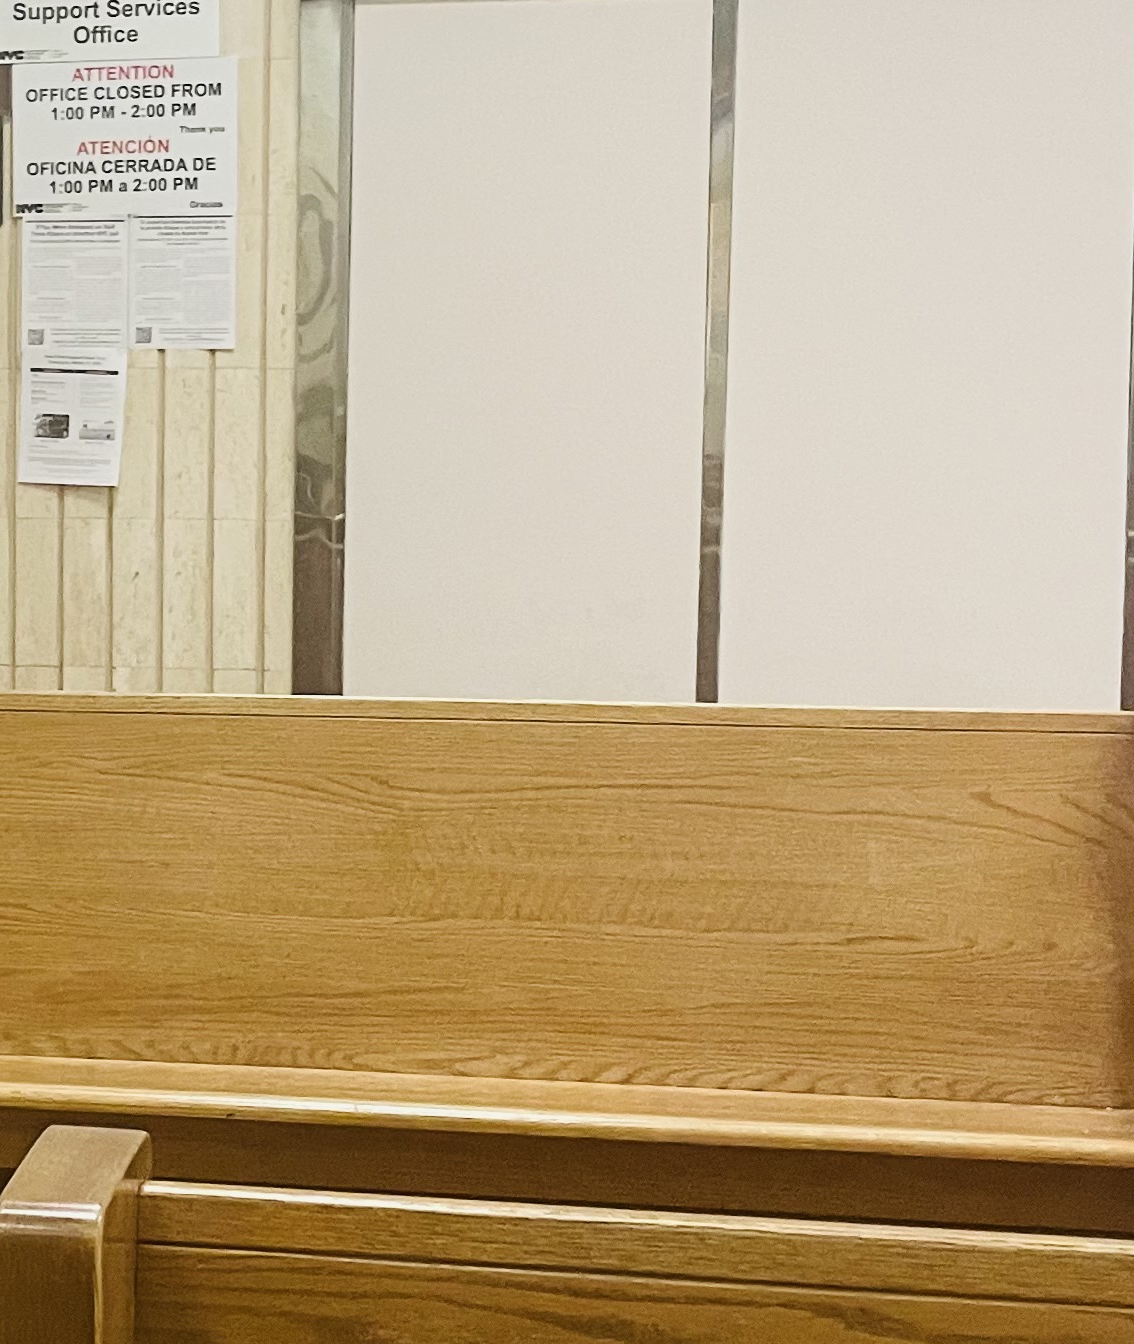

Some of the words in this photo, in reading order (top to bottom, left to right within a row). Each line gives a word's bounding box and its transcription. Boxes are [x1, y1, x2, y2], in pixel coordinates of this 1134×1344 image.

[13, 2, 100, 24] Support
[73, 25, 138, 44] Office
[72, 64, 175, 82] ATTENTION
[26, 87, 88, 103] OFFICE
[93, 84, 165, 100] CLOSED
[171, 83, 222, 98] FROM
[51, 106, 84, 121] 1:00
[90, 106, 115, 120] PM
[131, 104, 165, 118] 2:00
[171, 103, 196, 117] PM
[27, 161, 96, 176] OFICINA
[102, 158, 187, 174] CERRADA
[193, 157, 216, 171] DE
[49, 181, 82, 194] 1:00
[88, 180, 113, 193] PM
[119, 182, 127, 192] a
[133, 178, 167, 192] 2:00
[173, 177, 198, 190] PM
